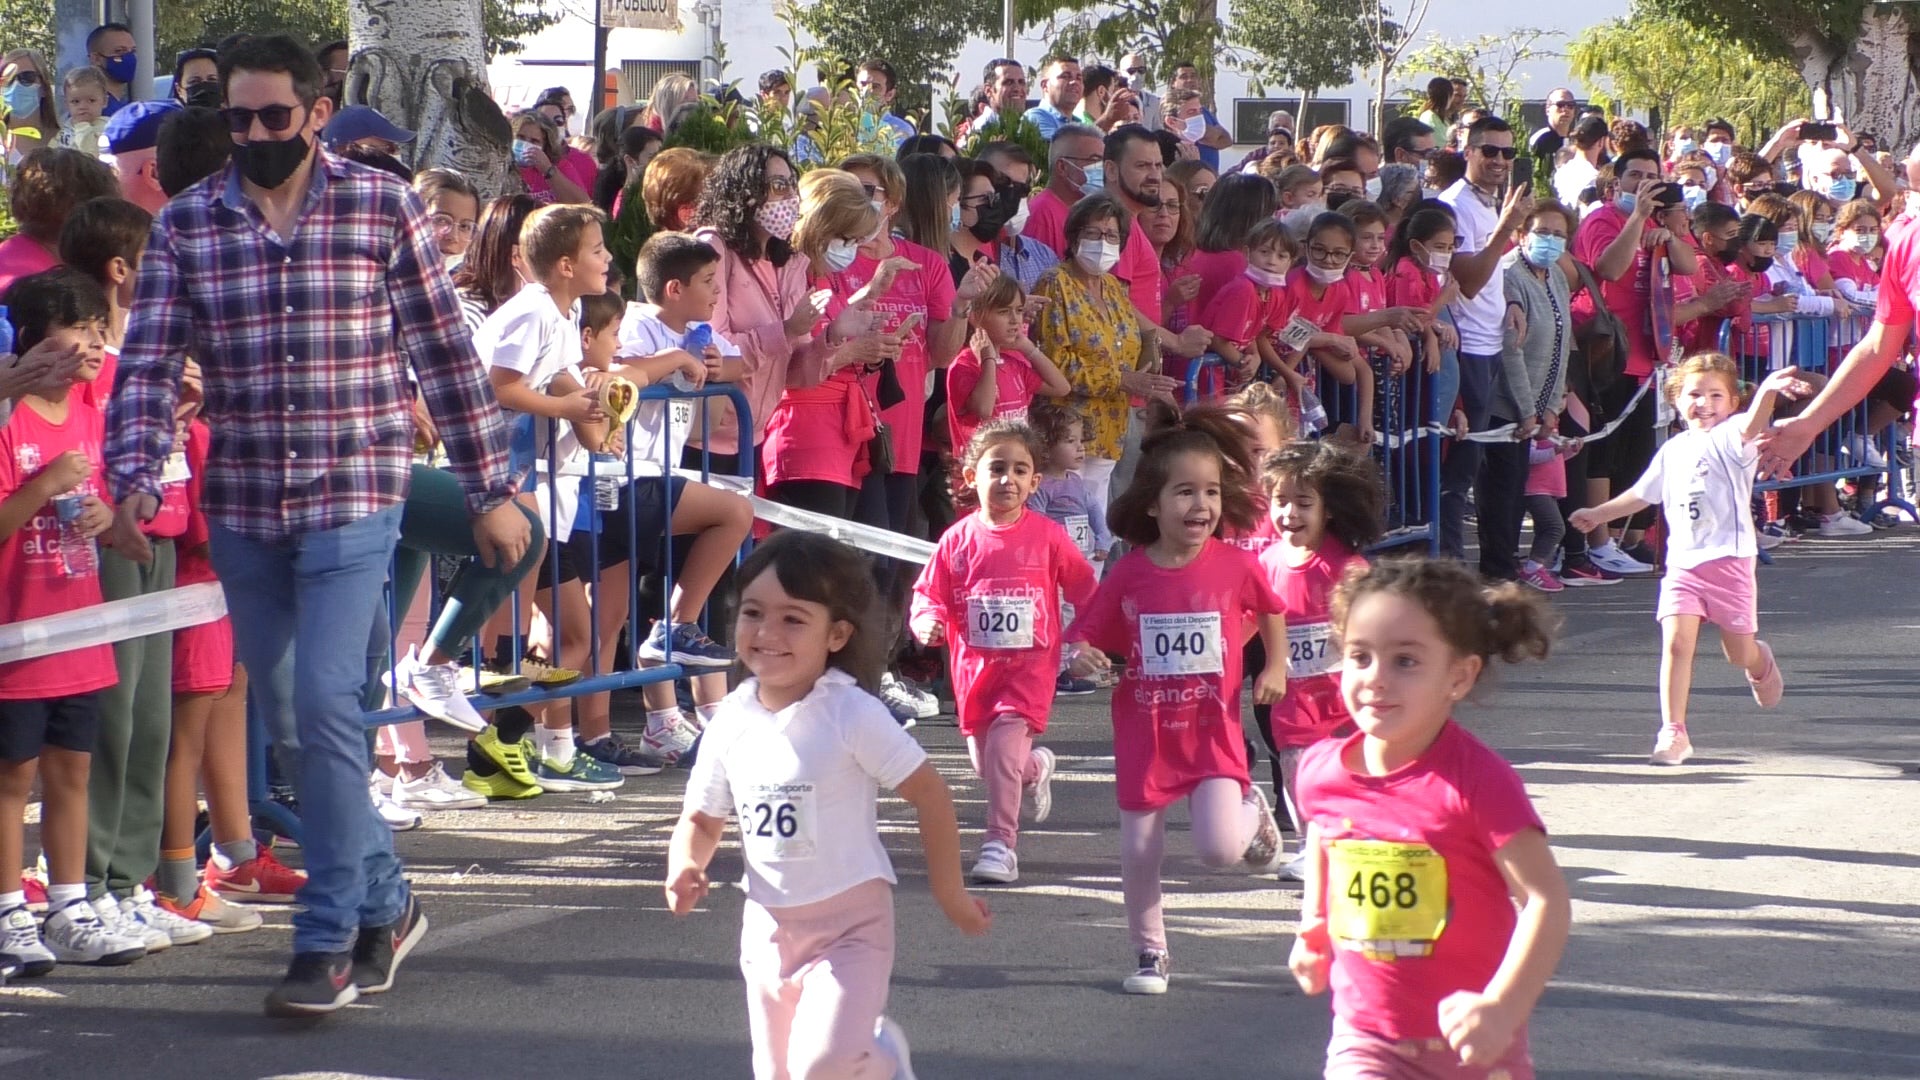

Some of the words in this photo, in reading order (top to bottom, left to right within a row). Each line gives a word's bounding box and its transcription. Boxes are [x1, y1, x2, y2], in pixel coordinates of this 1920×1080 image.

[978, 612, 1019, 633] 020
[1187, 615, 1219, 624] Deporte
[1155, 632, 1205, 657] 040
[1290, 638, 1328, 662] 287
[772, 784, 813, 794] Deporte
[1347, 870, 1418, 909] 468
